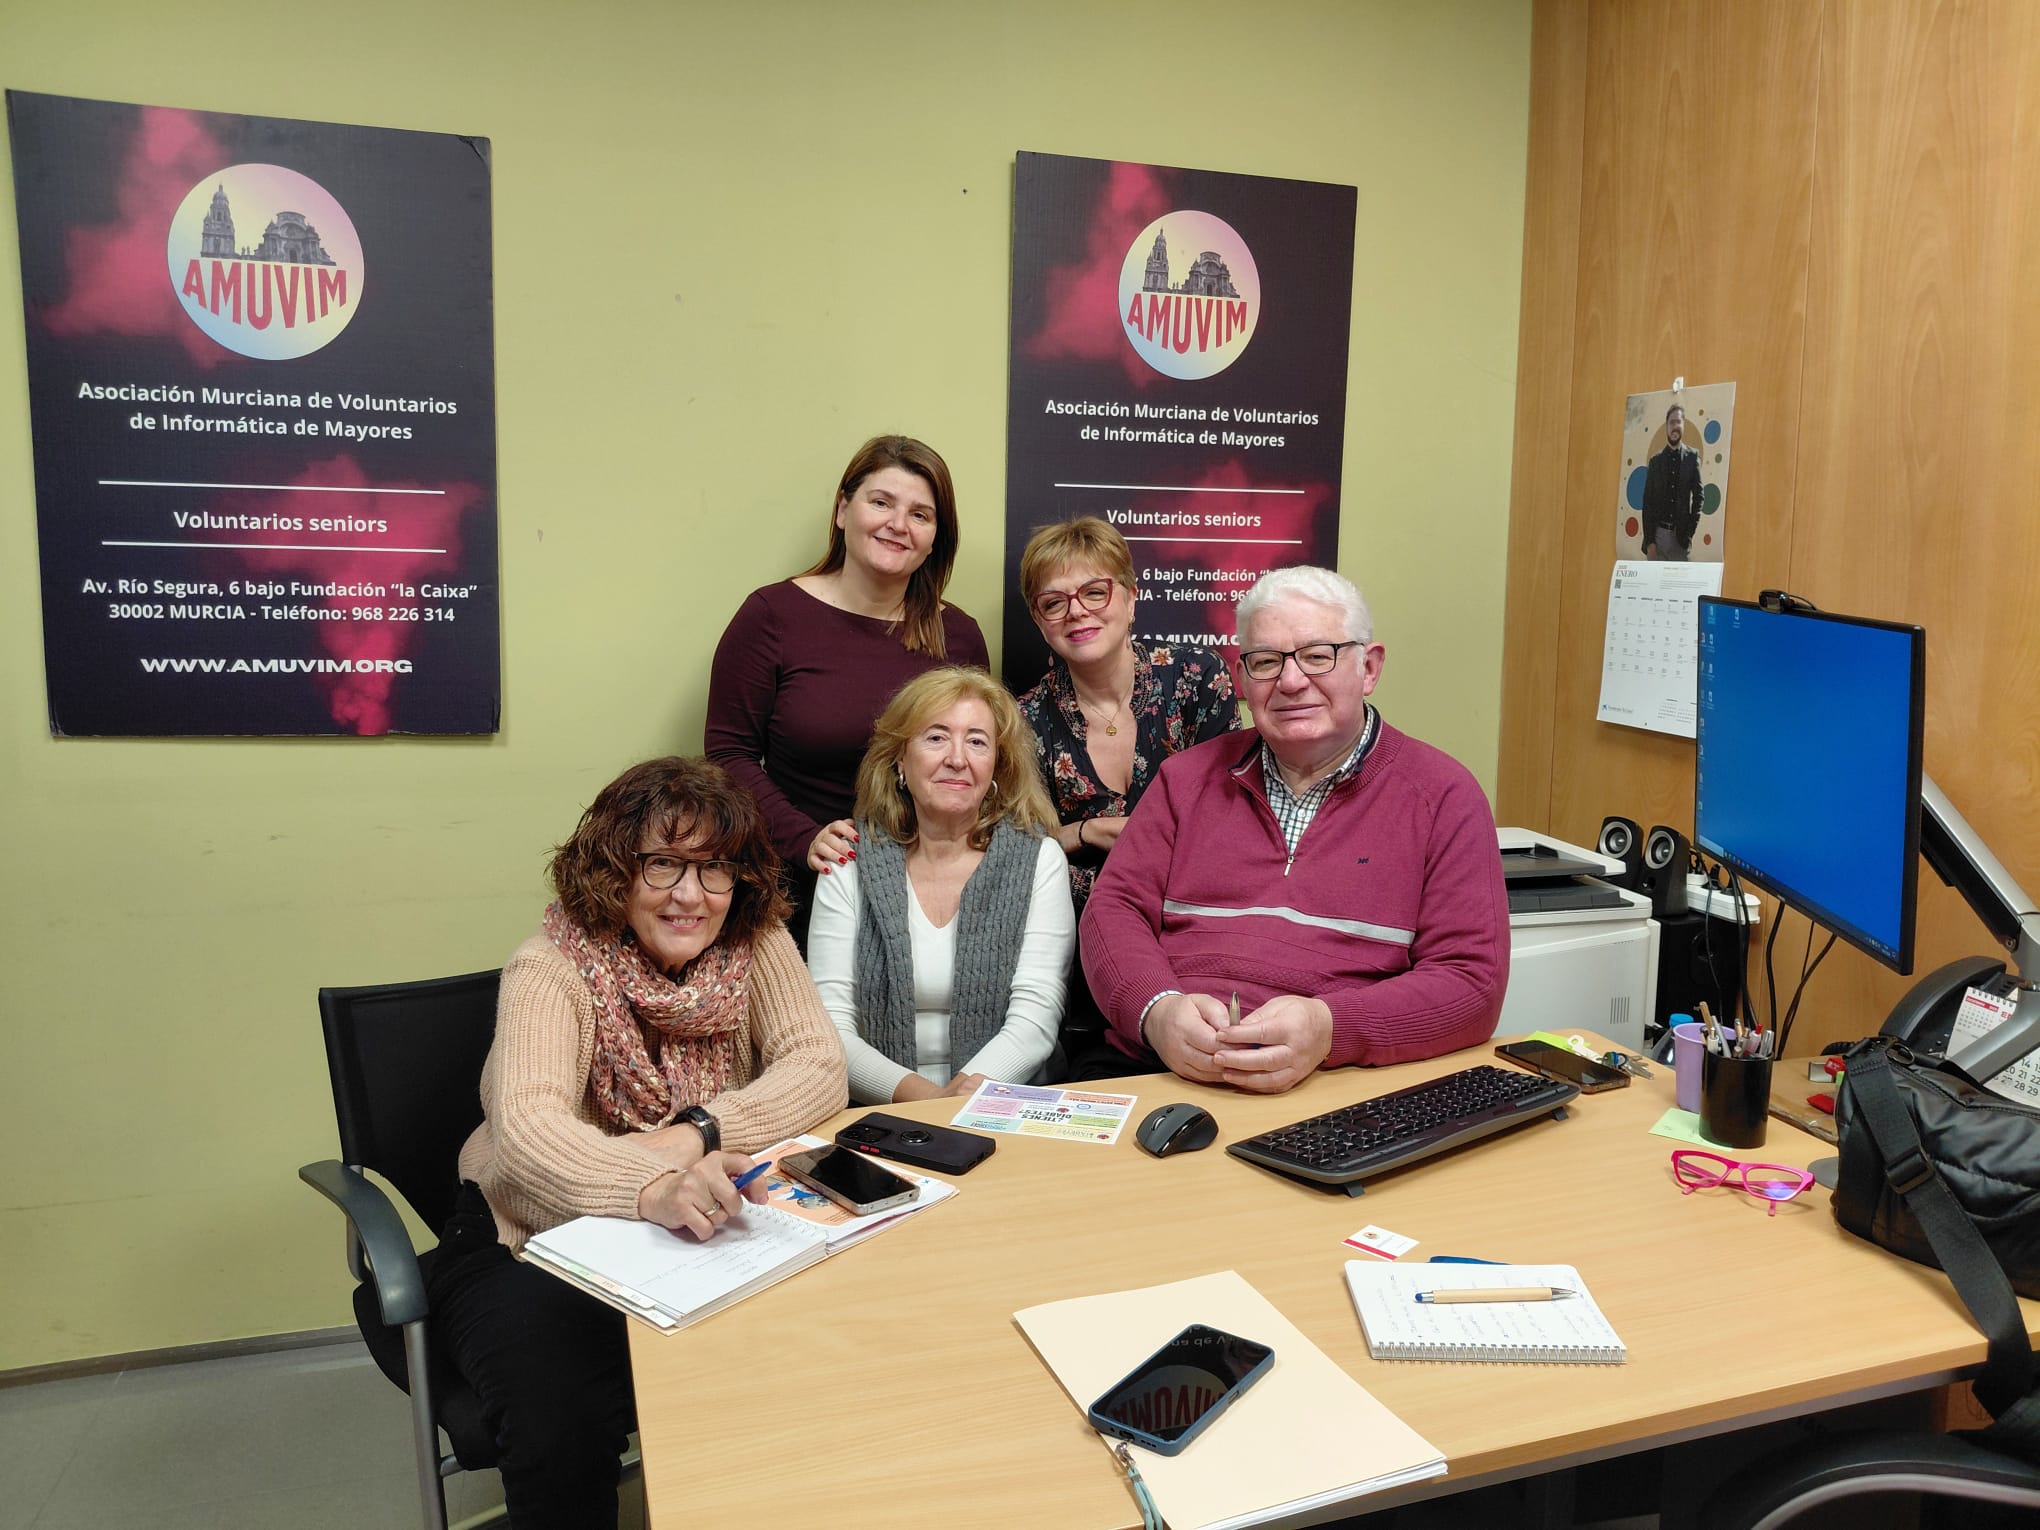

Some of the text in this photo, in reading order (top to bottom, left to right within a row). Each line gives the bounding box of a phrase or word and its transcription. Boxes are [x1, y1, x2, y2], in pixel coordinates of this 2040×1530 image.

[182, 259, 348, 330] AMUVIM
[1127, 293, 1248, 354] AMUVIM
[79, 383, 456, 414] Asociación Murciana de Voluntarios
[1046, 400, 1318, 424] Asociación Murciana de Voluntarios
[130, 413, 412, 441] de Informática de Mayores
[1081, 426, 1284, 449] de Informática de Mayores
[174, 512, 387, 532] Voluntarios seniors
[1107, 510, 1260, 526] Voluntarios seniors
[1143, 569, 1150, 580] 6
[1155, 568, 1183, 584] bajo
[1187, 568, 1257, 581] Fundación
[83, 579, 112, 593] Av.
[119, 579, 148, 593] Río
[154, 580, 223, 598] Segura,
[230, 581, 240, 595] 6
[246, 581, 285, 599] bajo
[291, 582, 385, 596] Fundación
[1165, 589, 1226, 601] Teléfono:
[110, 604, 164, 618] 30002
[170, 605, 245, 619] MURCIA
[261, 606, 346, 620] Teléfono:
[352, 607, 383, 620] 968
[389, 608, 419, 620] 226
[424, 608, 454, 621] 314
[141, 659, 412, 673] WWW.AMUVIM.ORG
[2021, 1058, 2031, 1068] 14
[2018, 1069, 2028, 1080] 21
[2014, 1080, 2026, 1091] 28
[2027, 1085, 2039, 1097] 29
